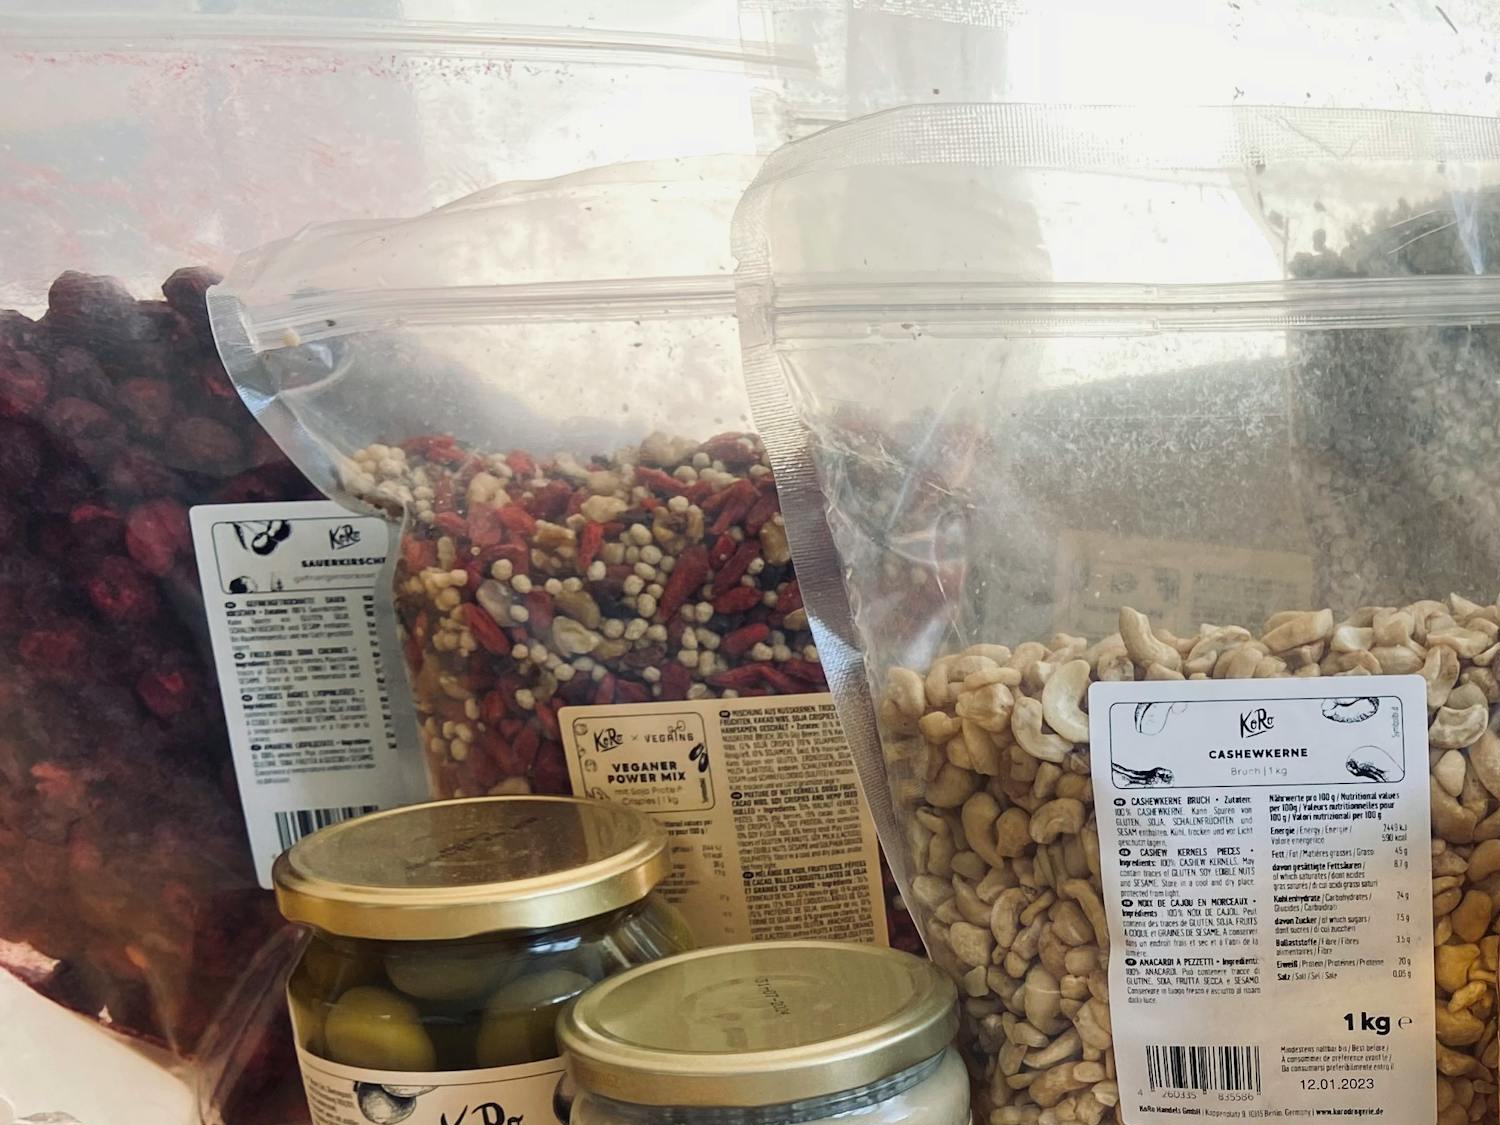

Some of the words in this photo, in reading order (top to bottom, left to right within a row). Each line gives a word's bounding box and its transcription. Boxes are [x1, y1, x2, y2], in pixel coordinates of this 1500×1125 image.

[329, 524, 361, 549] KoRo
[1240, 708, 1274, 738] KoRo
[594, 728, 624, 752] KoRo
[1209, 748, 1308, 760] CASHEWKERNE
[612, 761, 677, 772] VEGANER
[1230, 767, 1261, 776] Bruch
[1275, 767, 1288, 777] kg
[608, 773, 656, 784] POWER
[661, 772, 686, 781] MIX
[1132, 797, 1182, 805] CASHEWKERNE
[1187, 796, 1210, 804] BRUCH
[1140, 848, 1168, 856] CASHEW
[1344, 1013, 1353, 1031] 1
[1361, 1012, 1391, 1035] kg
[1299, 1078, 1374, 1090] 12.01.2023
